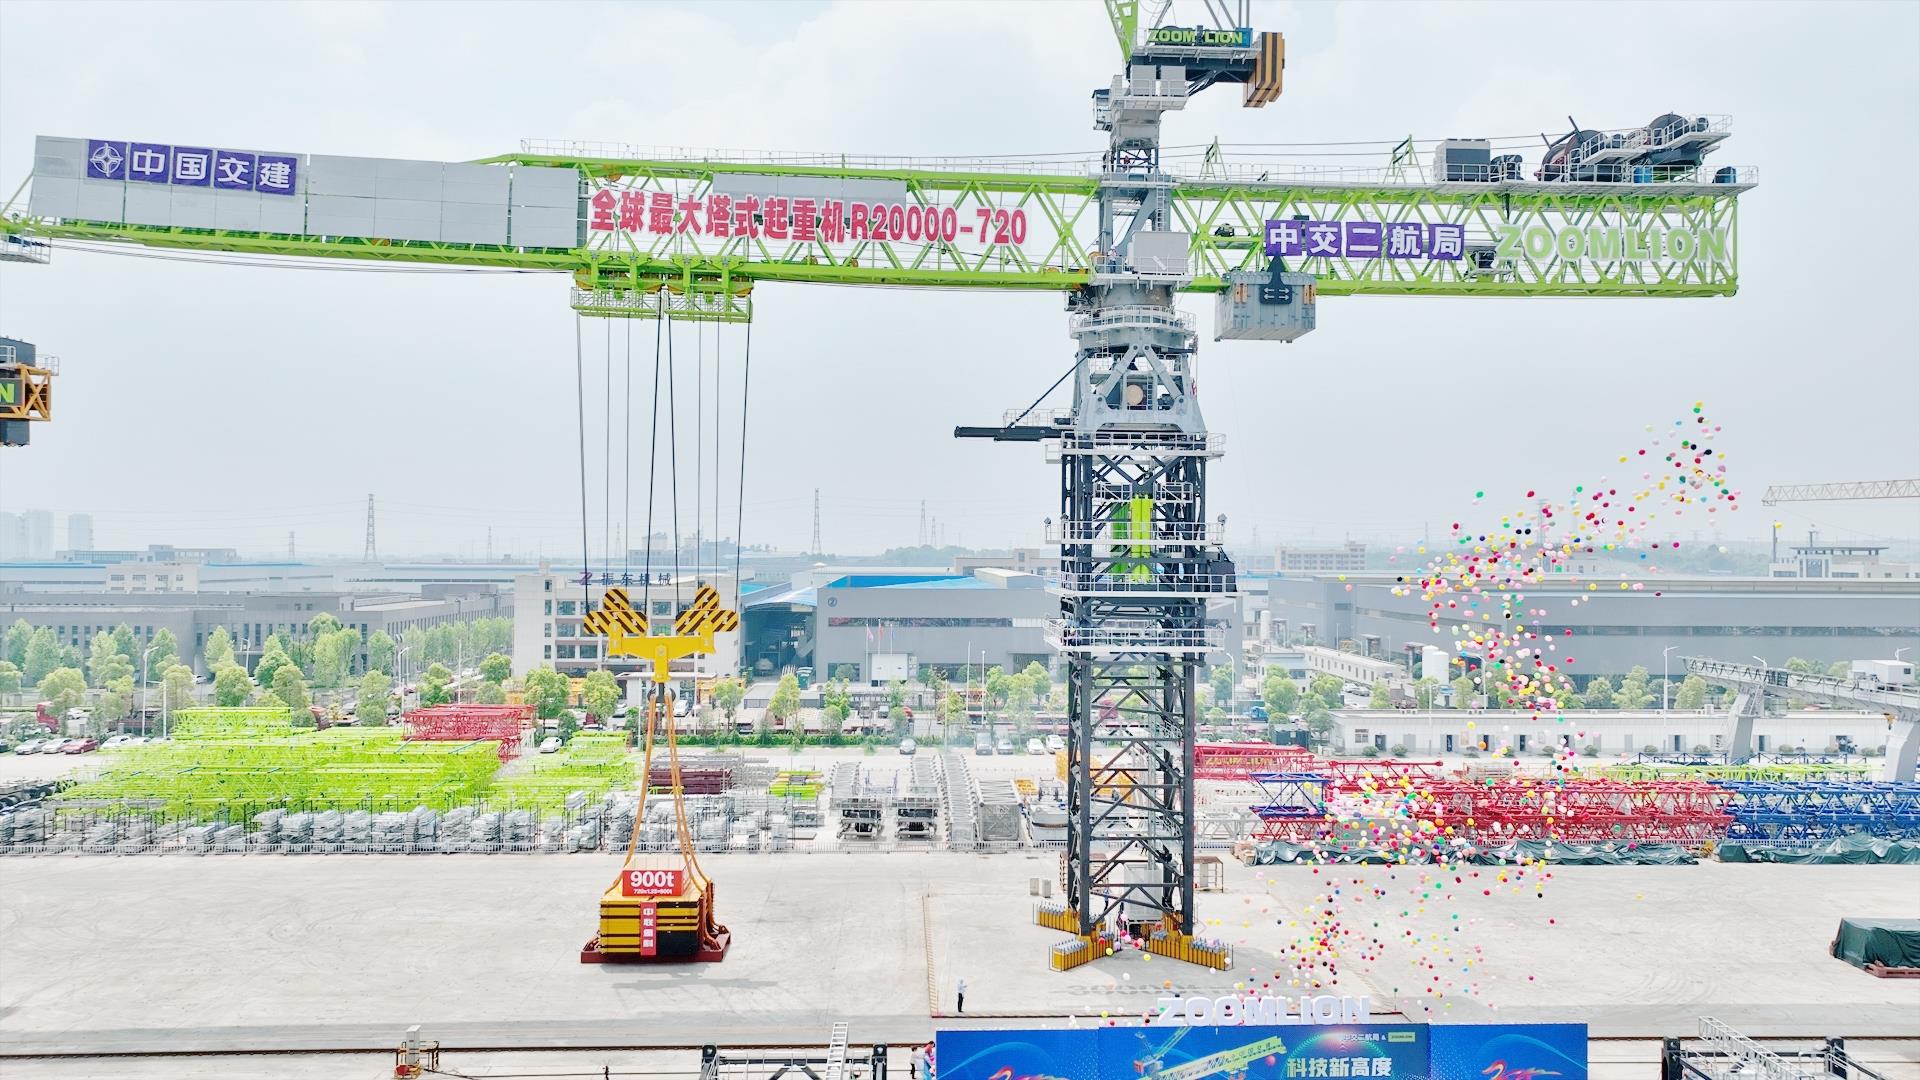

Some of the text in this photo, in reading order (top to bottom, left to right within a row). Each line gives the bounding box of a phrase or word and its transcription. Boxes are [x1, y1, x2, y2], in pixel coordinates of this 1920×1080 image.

[1149, 29, 1242, 44] ZOOMLION
[132, 148, 291, 188] 中国交建
[1269, 222, 1463, 259] 中交二航局
[1496, 223, 1728, 262] ZOOMLION
[630, 871, 674, 887] 900t
[1158, 995, 1370, 1025] ZOOMLION
[1287, 1056, 1392, 1078] 科技新高度
